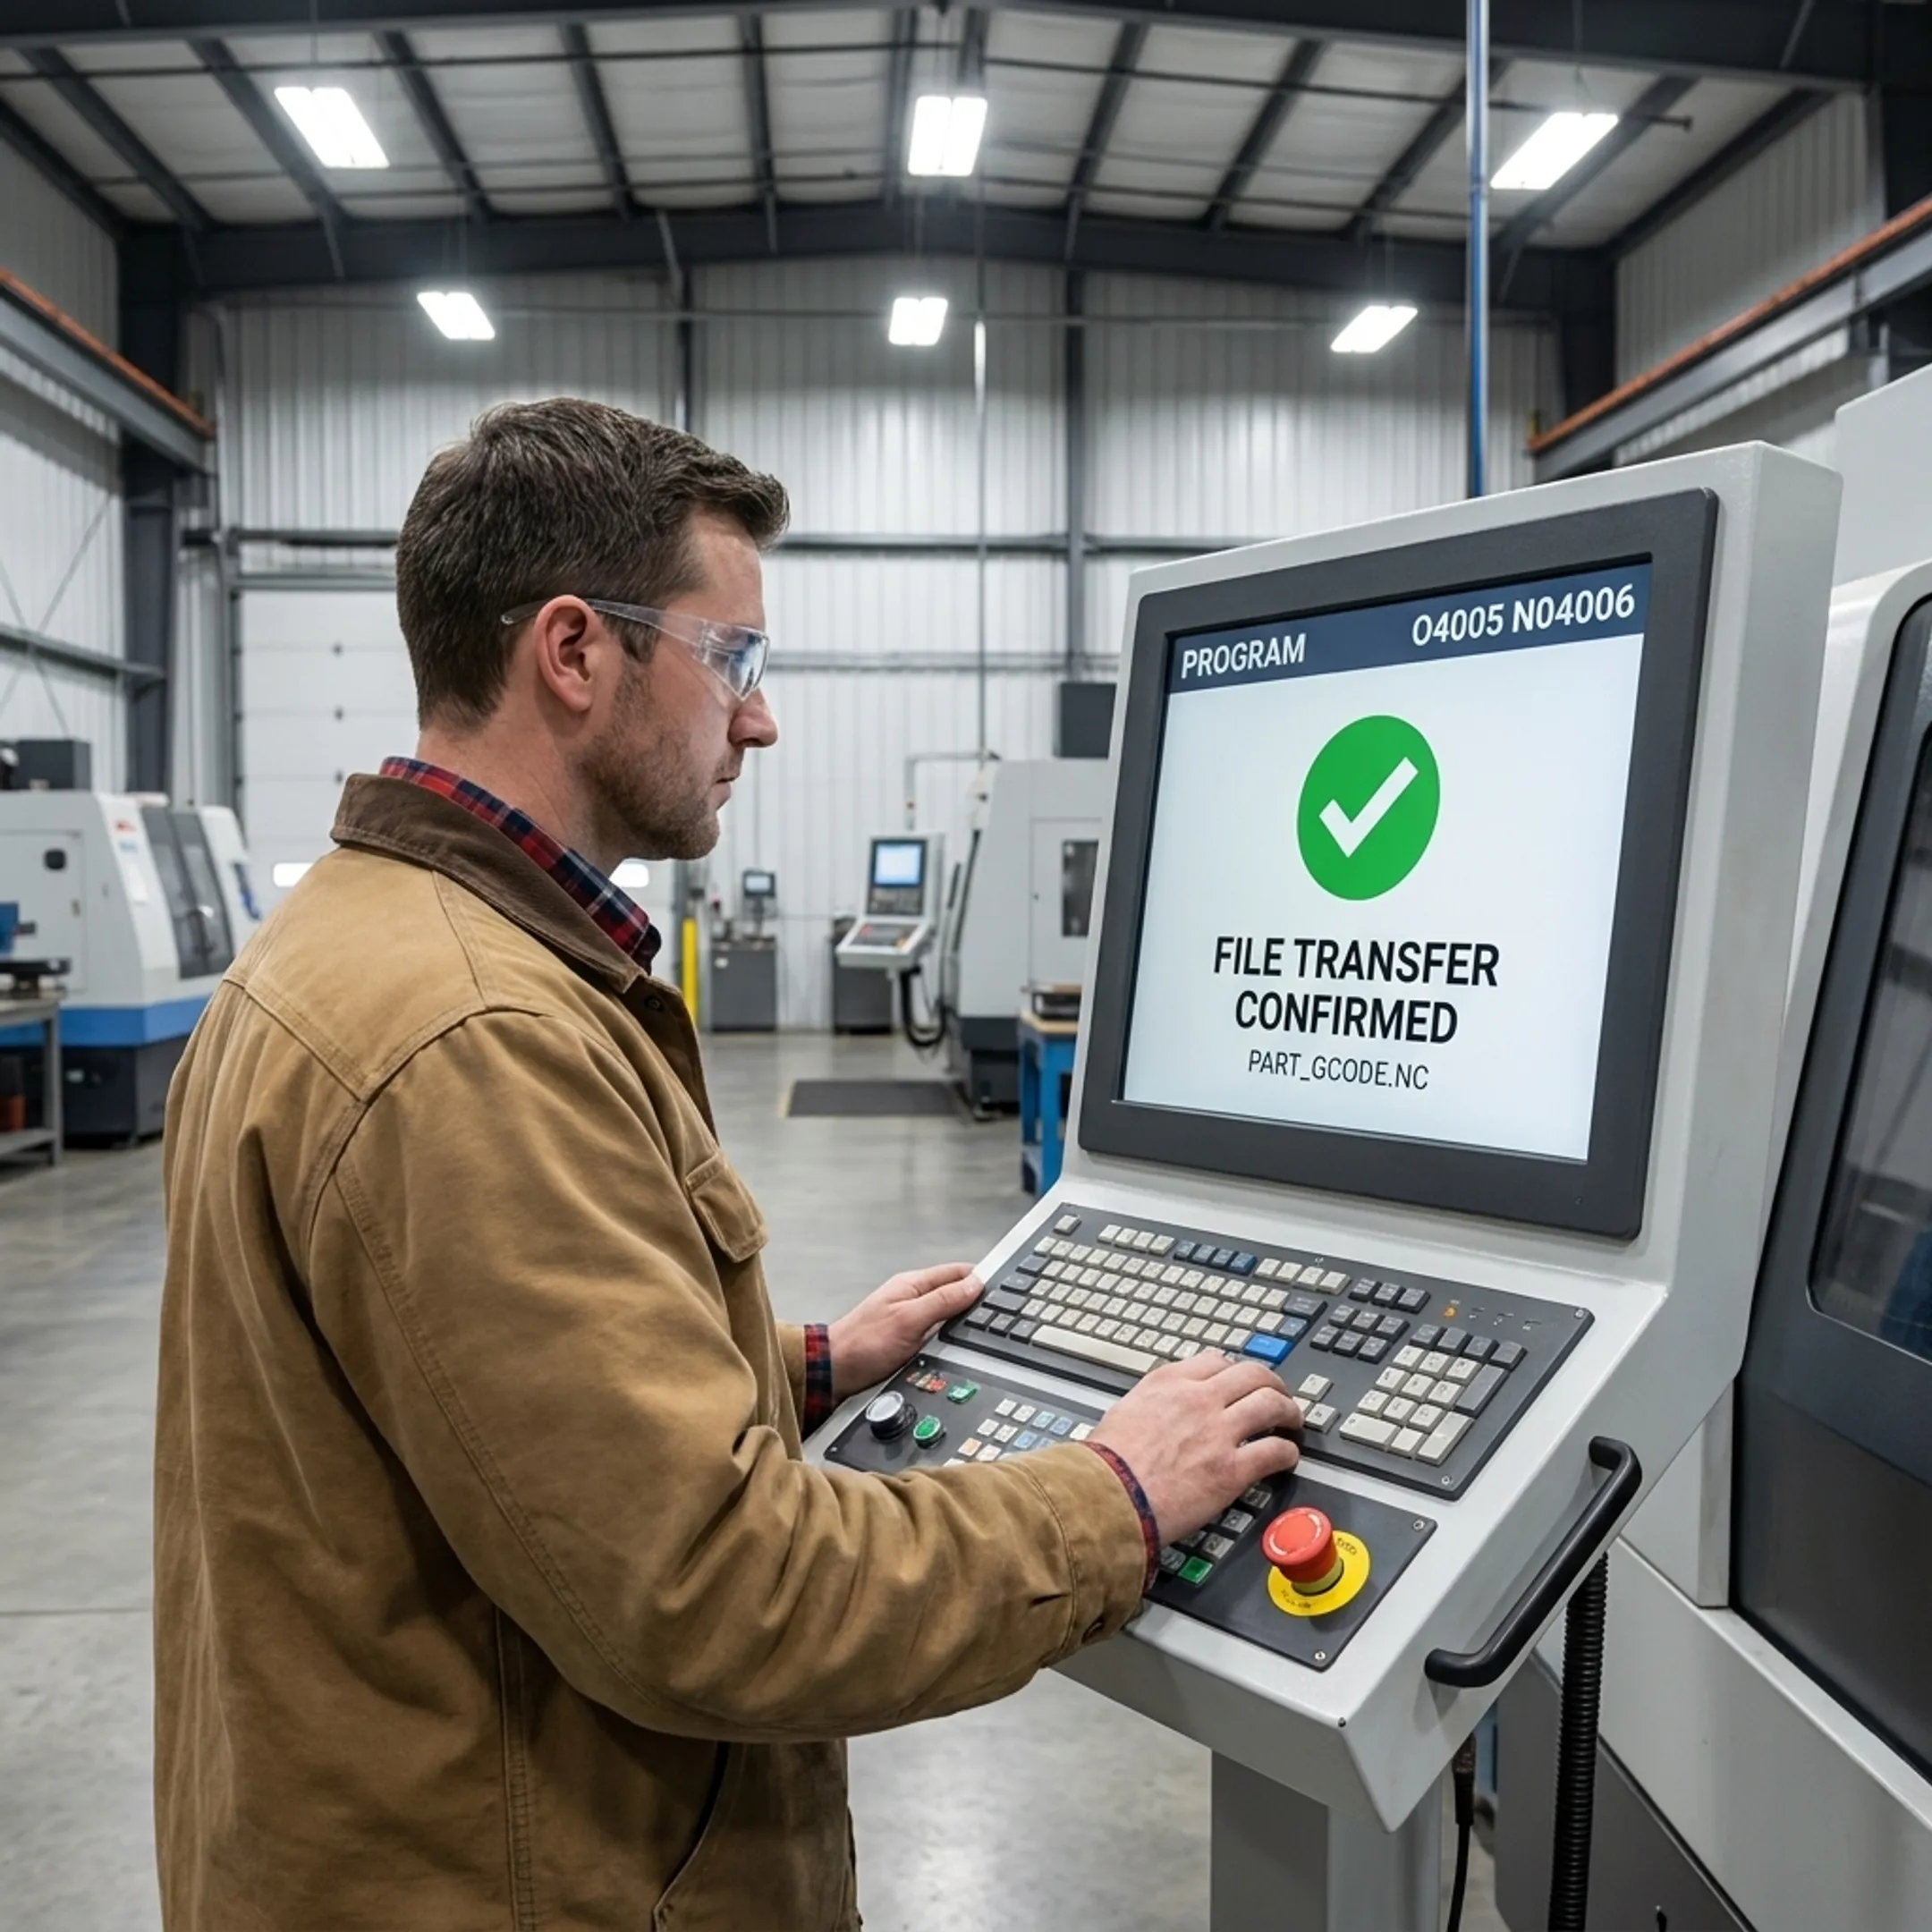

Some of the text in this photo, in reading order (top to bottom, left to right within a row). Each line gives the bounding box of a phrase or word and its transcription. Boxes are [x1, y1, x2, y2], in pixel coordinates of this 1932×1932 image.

[1181, 633, 1306, 679] PROGRAM
[1213, 936, 1500, 987] FILE TRANSFER
[1235, 989, 1458, 1045] CONFIRMED
[1248, 1048, 1429, 1091] PART_GCODE.NC
